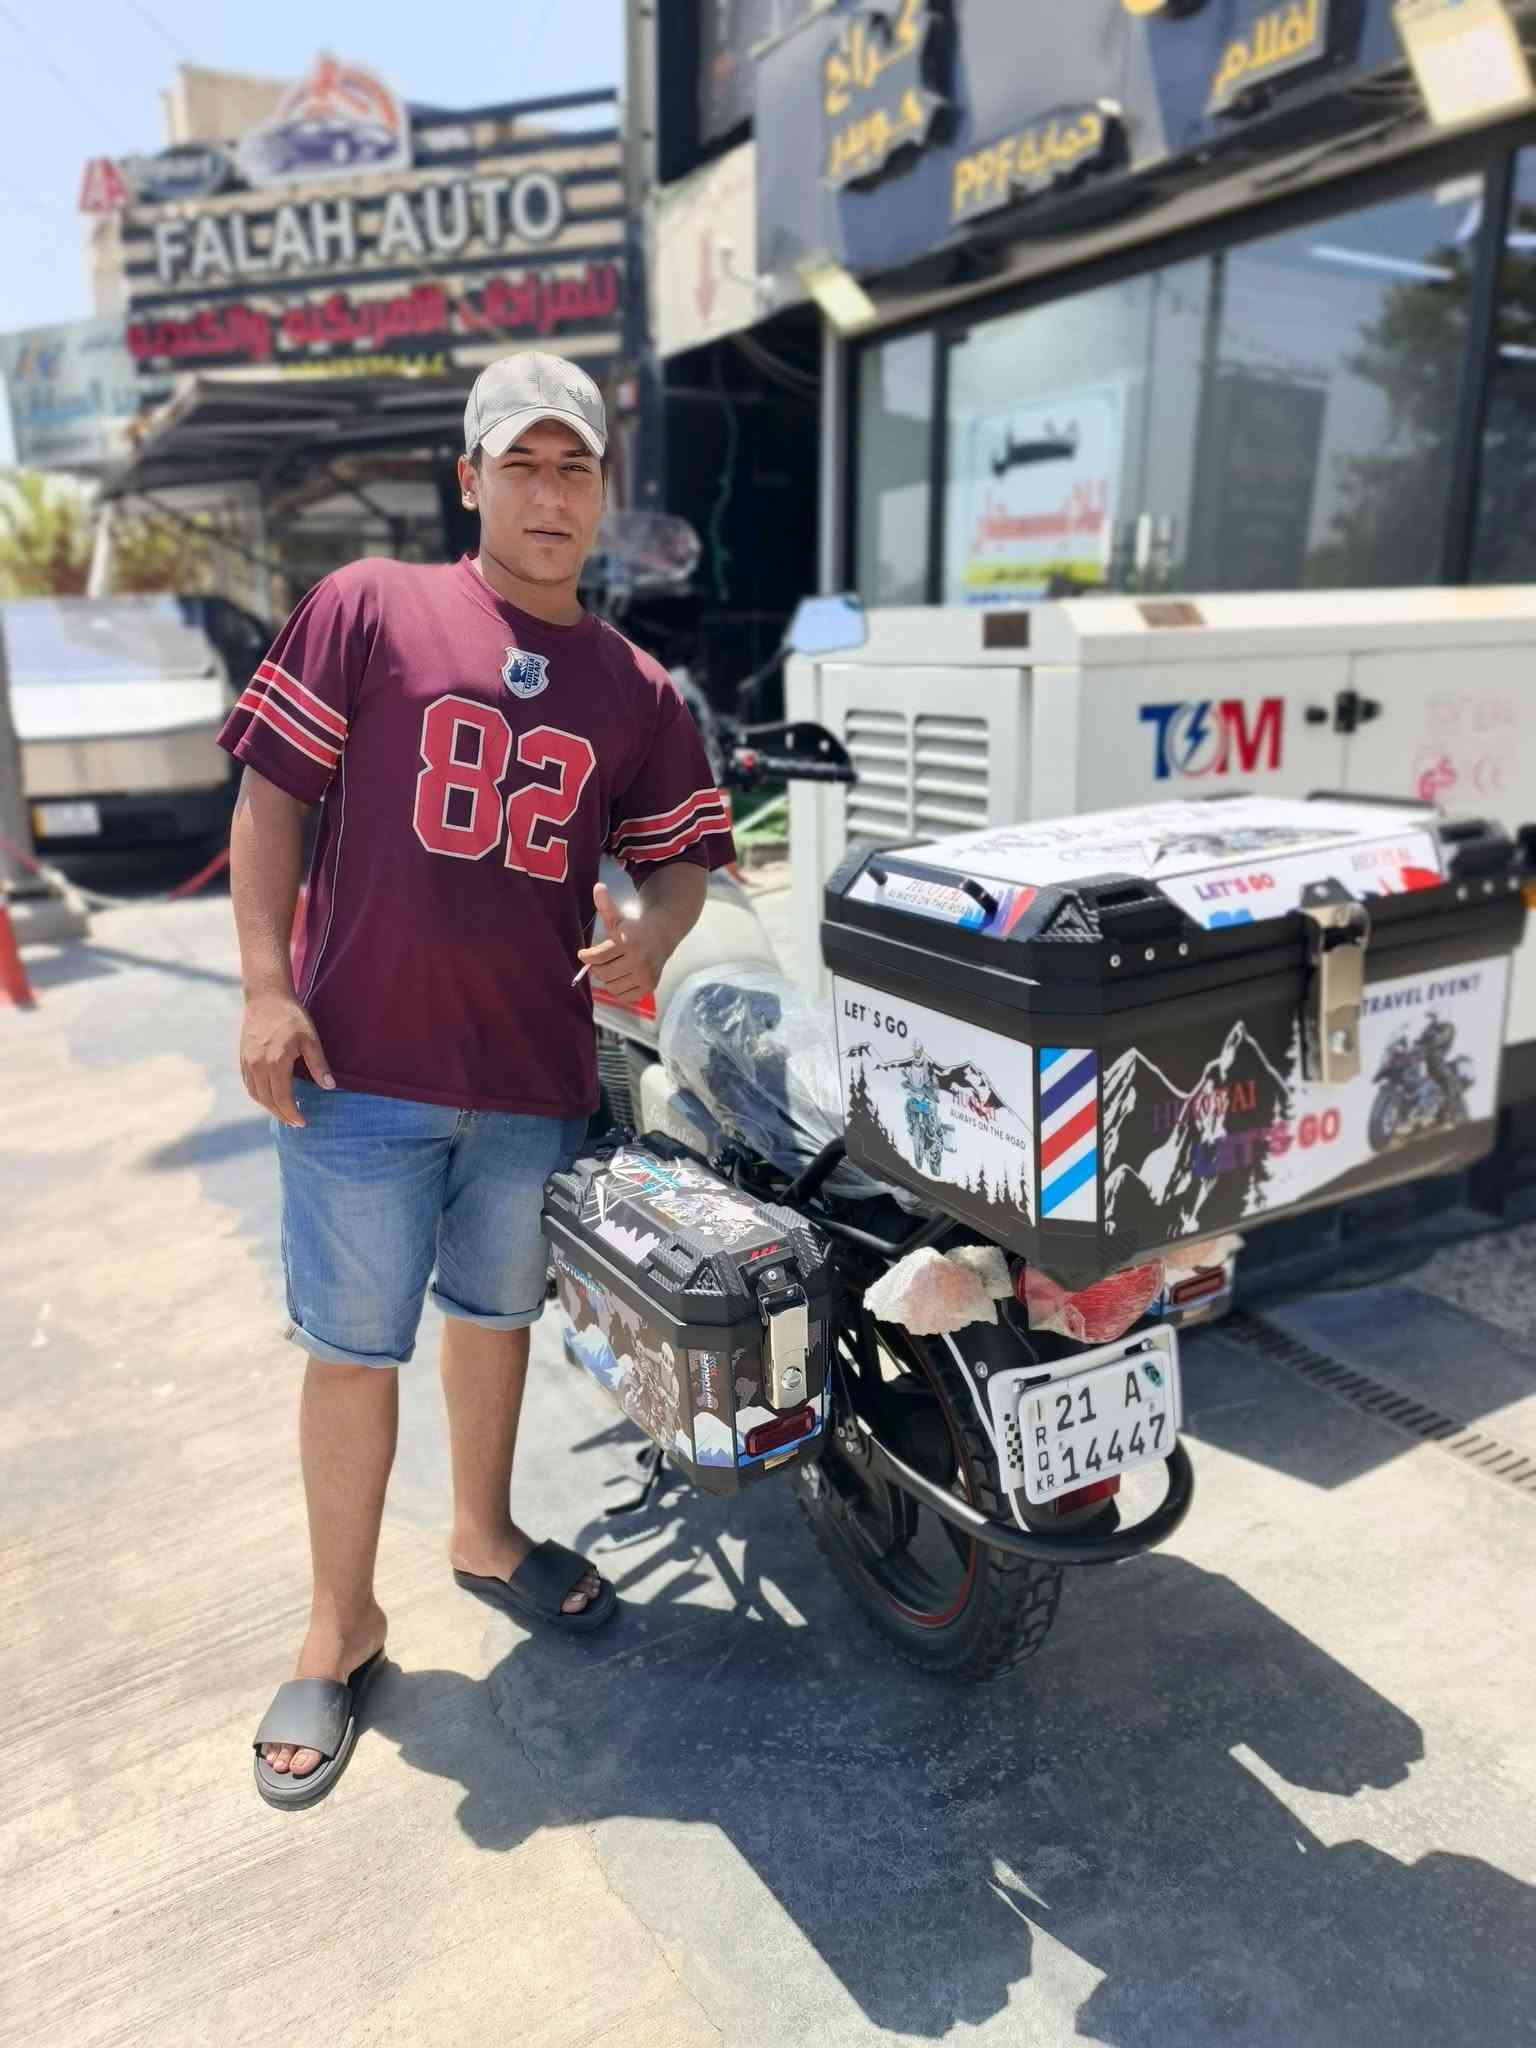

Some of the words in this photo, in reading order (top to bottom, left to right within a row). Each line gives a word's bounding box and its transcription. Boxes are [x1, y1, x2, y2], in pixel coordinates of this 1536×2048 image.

[953, 141, 1016, 214] PPF
[154, 199, 355, 283] FALAH
[377, 172, 562, 258] AUTO
[1138, 696, 1285, 781] TOM
[413, 693, 597, 883] 82
[1248, 872, 1275, 892] GO
[885, 1015, 908, 1039] GO
[990, 1126, 1004, 1141] THE
[1004, 1133, 1026, 1151] ROAD
[1298, 1107, 1341, 1149] GO
[1055, 1386, 1097, 1432] 21
[1124, 1371, 1142, 1409] A
[1061, 1412, 1166, 1484] 14447
[1036, 1473, 1055, 1492] KR
